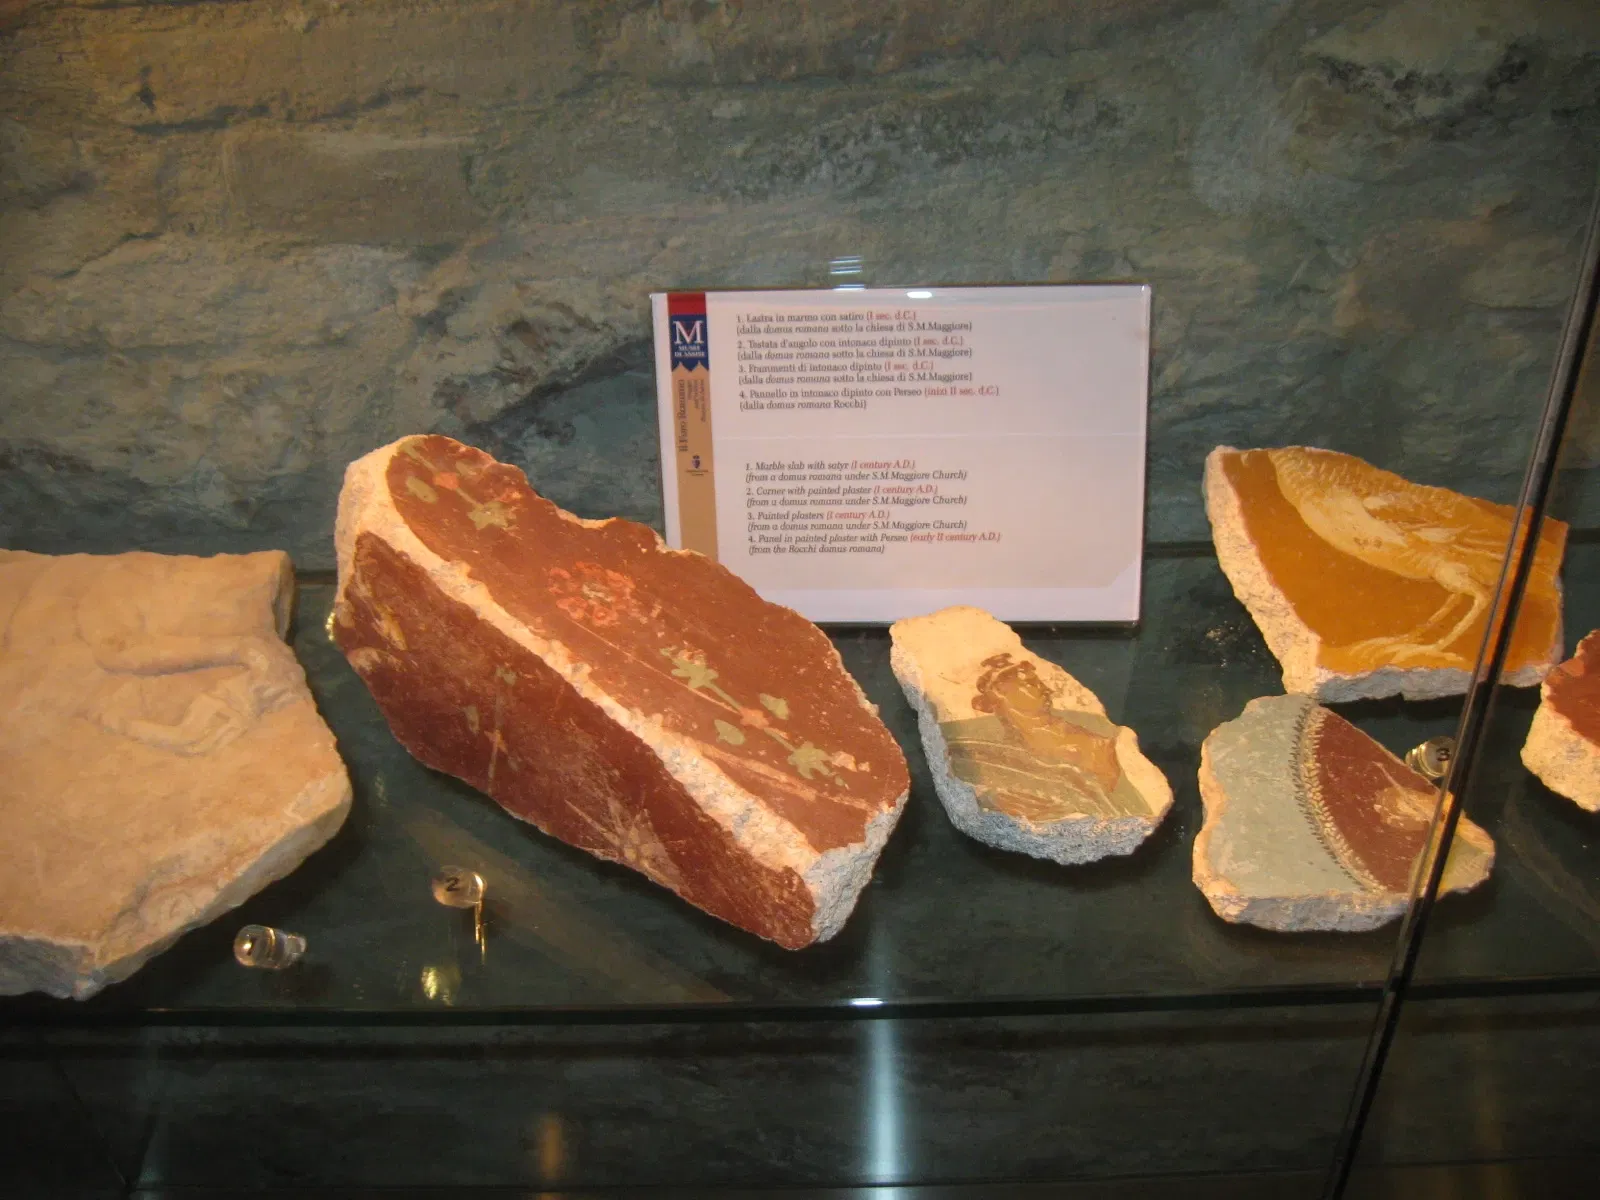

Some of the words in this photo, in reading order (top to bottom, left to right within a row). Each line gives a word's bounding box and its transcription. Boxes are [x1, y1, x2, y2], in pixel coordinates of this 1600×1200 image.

[673, 320, 704, 344] M
[1436, 748, 1452, 761] 3
[446, 877, 460, 892] 2
